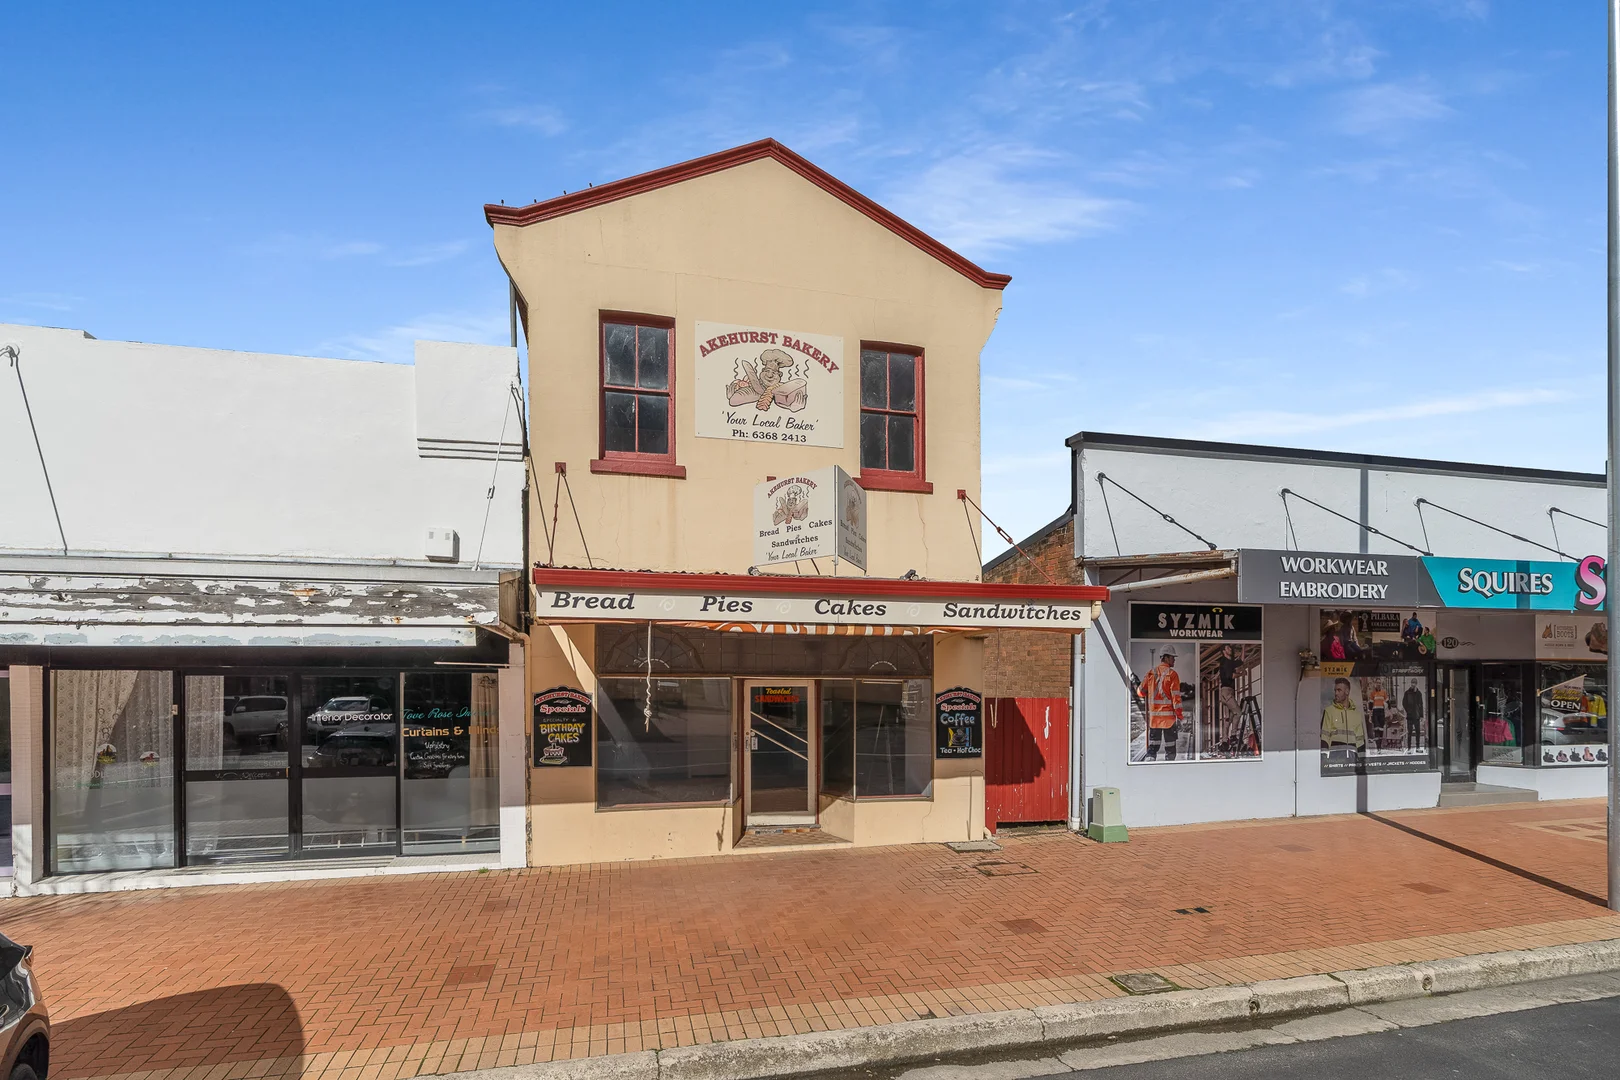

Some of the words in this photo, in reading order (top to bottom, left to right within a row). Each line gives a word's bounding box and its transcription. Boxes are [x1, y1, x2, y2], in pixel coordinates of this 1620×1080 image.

[699, 331, 778, 357] AKEHURST
[782, 335, 840, 374] BAKERY
[752, 414, 780, 429] Local
[732, 429, 748, 438] Ph:
[752, 430, 778, 441] 6368
[781, 433, 807, 443] 2413
[767, 477, 795, 498] AKEHURST
[795, 477, 817, 490] BAKERY
[759, 528, 779, 537] Bread
[786, 524, 801, 533] Pies
[808, 520, 833, 529] Cakes
[771, 535, 819, 548] Sandwitches
[1280, 556, 1389, 576] WORKWEAR
[1458, 567, 1554, 599] SQUIRES
[1279, 581, 1389, 600] EMBROIDERY
[551, 591, 635, 610] Bread
[700, 595, 753, 613] Pies
[814, 599, 887, 616] Cakes
[943, 602, 1082, 621] Sandwitches
[1370, 612, 1400, 621] PILBARA
[1170, 629, 1223, 638] WORKWEAR
[1443, 638, 1458, 648] 120
[765, 687, 792, 695] Toasted
[755, 695, 800, 703] SANDWICHES
[1551, 699, 1581, 710] OPEN
[428, 707, 453, 720] Rose
[540, 704, 586, 714] Specials
[940, 703, 976, 712] Specials
[311, 712, 344, 721] Interior
[345, 712, 393, 721] Decorator
[940, 713, 975, 726] Coffee
[401, 725, 450, 737] Curtains
[454, 726, 464, 736] &
[539, 723, 586, 734] BIRTHDAY
[547, 733, 580, 743] CAKES
